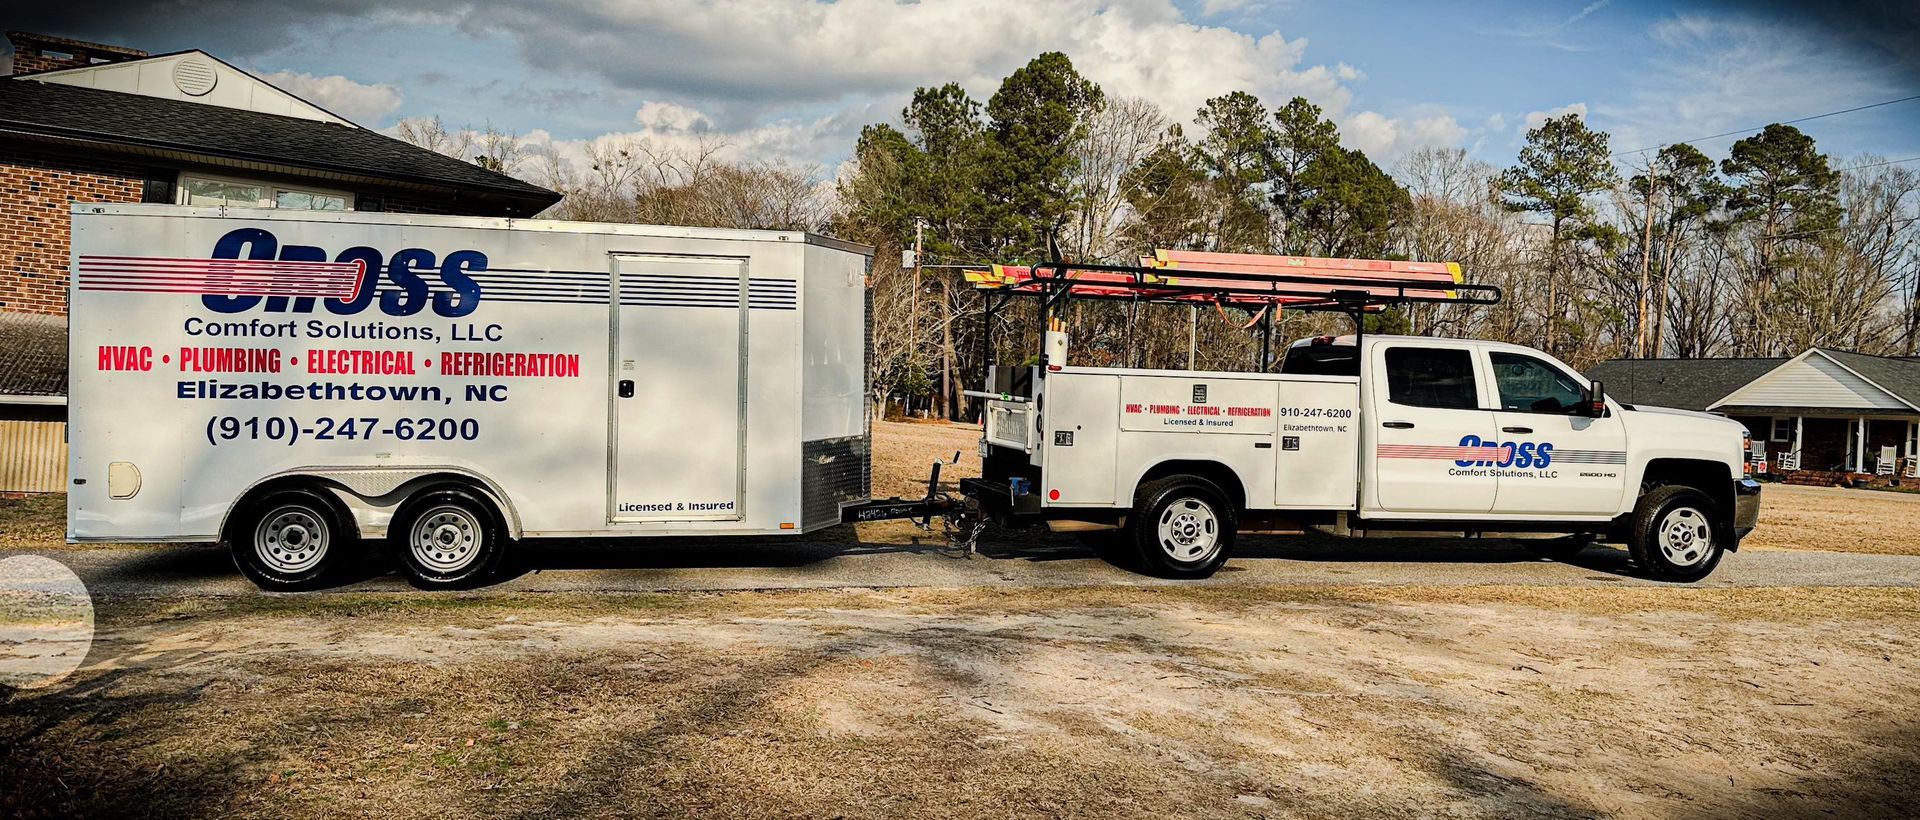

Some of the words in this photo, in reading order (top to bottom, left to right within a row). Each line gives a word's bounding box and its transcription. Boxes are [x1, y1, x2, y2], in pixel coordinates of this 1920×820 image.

[184, 317, 297, 339] Comfort
[306, 319, 441, 343] Solutions,
[451, 323, 503, 342] LLC
[98, 345, 153, 371] HVAC
[180, 346, 281, 373] PLUMBING
[307, 350, 415, 375] ELECTRICAL
[441, 353, 580, 378] REFRIGERATION
[177, 381, 452, 404] Elizabethtown,
[465, 384, 509, 402] NC
[1126, 404, 1142, 414] HVAC
[1150, 405, 1180, 414] PLUMBING
[1187, 406, 1221, 416] ELECTRICAL
[1228, 407, 1271, 417] REFRIGERATION
[1280, 407, 1352, 418] 910-247-6200
[1163, 418, 1197, 426] Licensed
[1206, 419, 1234, 427] Insured
[1283, 424, 1335, 432] Elizabethtown,
[206, 415, 480, 446] (910)-247-6200
[1448, 468, 1487, 477] Comfort
[1489, 469, 1536, 479] Solutions,
[1539, 470, 1558, 479] LLC
[618, 502, 673, 513] Licensed
[676, 502, 685, 512] &
[688, 500, 735, 512] Insured
